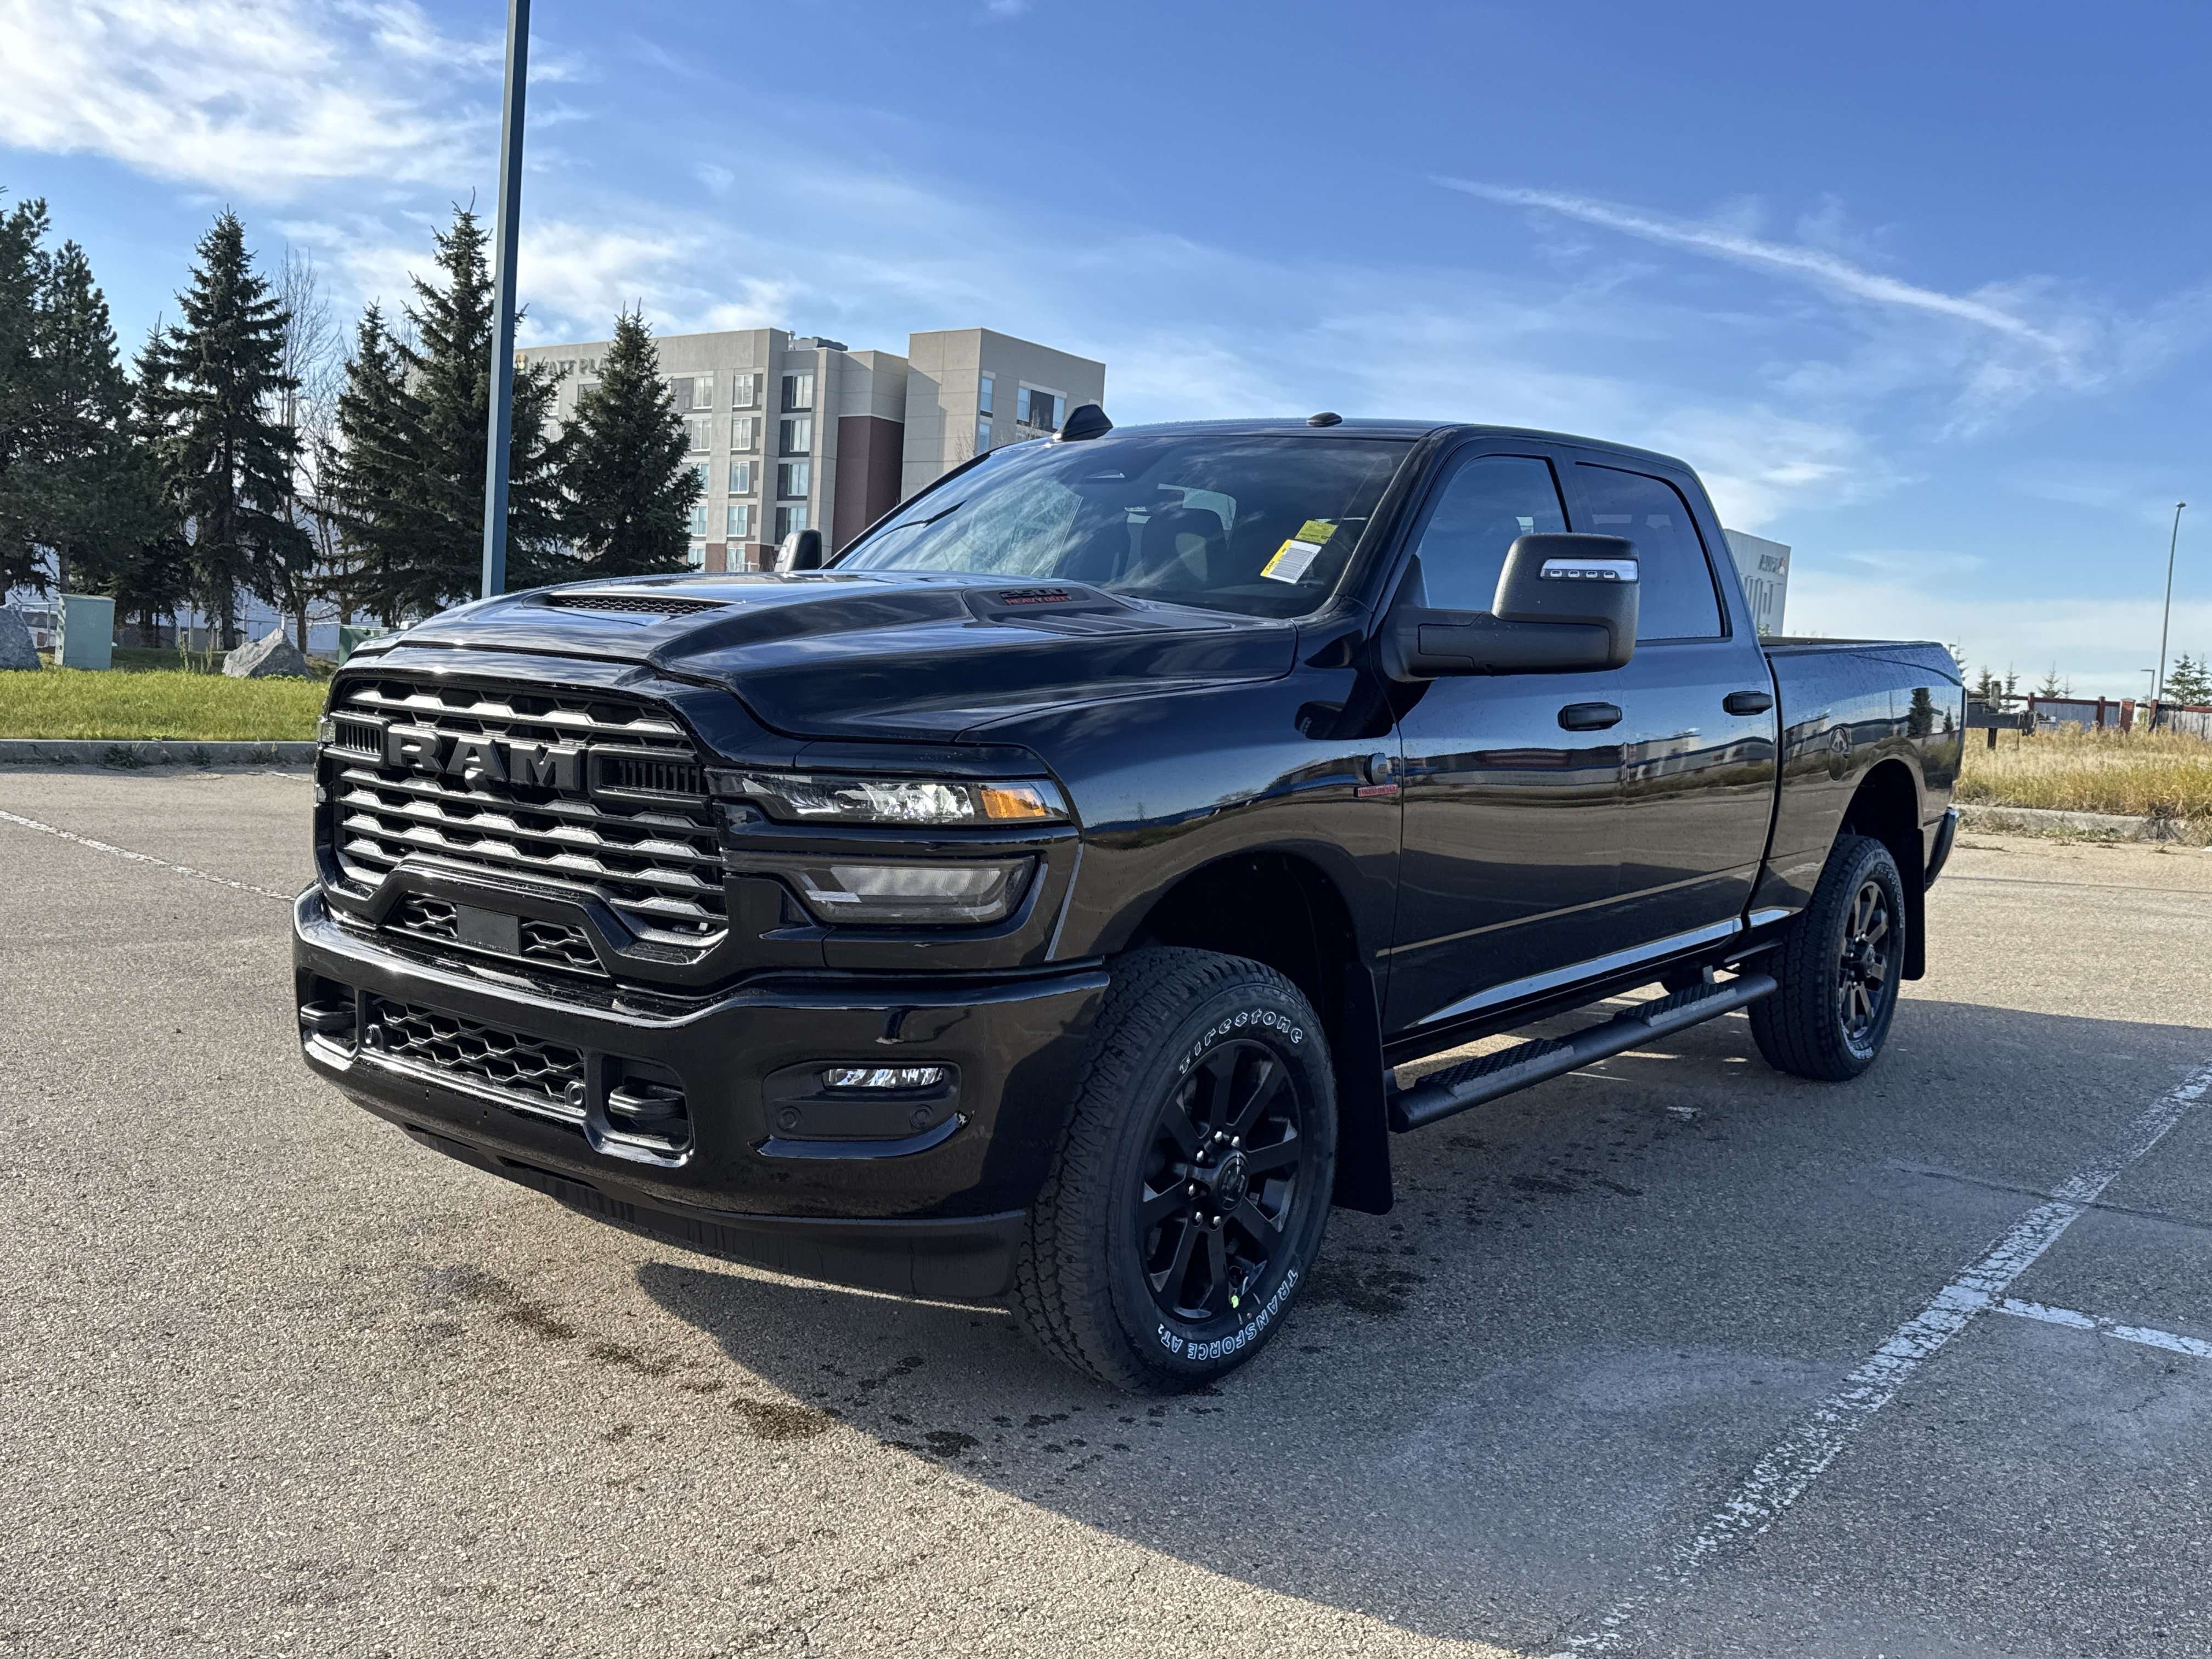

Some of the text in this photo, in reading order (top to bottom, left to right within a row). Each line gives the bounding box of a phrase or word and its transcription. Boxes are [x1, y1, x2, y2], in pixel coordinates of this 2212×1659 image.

[998, 589, 1069, 599] 2500
[387, 723, 580, 791] RAM
[1179, 1008, 1303, 1075] Firestone
[1187, 1269, 1299, 1361] TRANSFORCE
